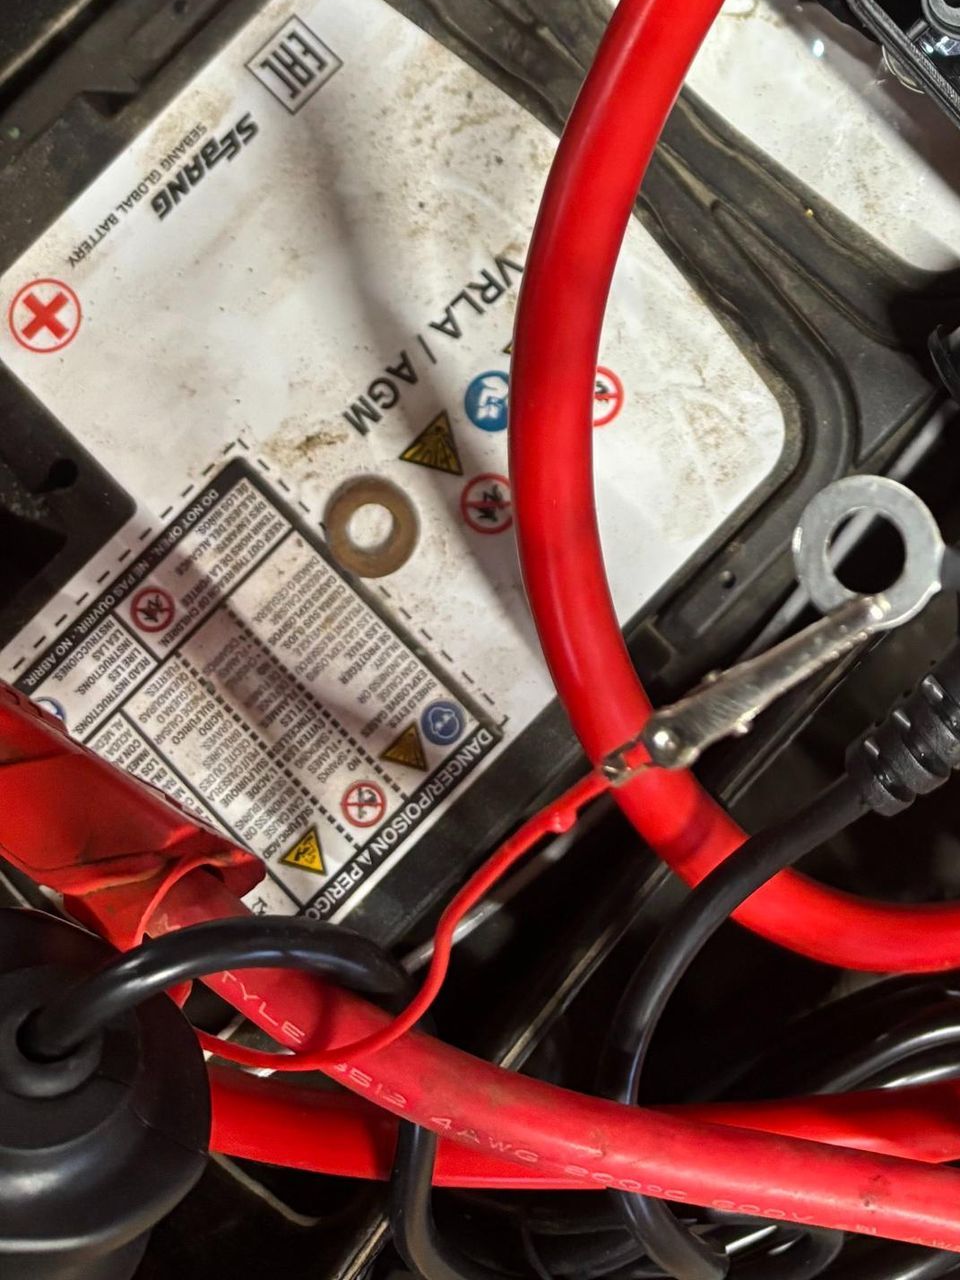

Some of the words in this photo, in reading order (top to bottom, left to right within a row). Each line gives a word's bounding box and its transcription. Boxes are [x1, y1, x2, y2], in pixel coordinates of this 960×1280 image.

[157, 121, 207, 171] SEBANG
[148, 111, 261, 221] SEBANG
[114, 167, 163, 217] GLOBAL
[64, 212, 119, 268] BATTERY
[428, 257, 524, 337] VRLA
[341, 348, 418, 437] AGM
[200, 488, 220, 509] DO
[218, 492, 239, 513] LOS
[247, 499, 268, 521] DES
[178, 503, 205, 530] NOT
[229, 531, 255, 557] HORS
[261, 518, 286, 544] KEEP
[218, 552, 234, 569] DE
[246, 538, 266, 559] OUT
[208, 563, 223, 579] LA
[111, 572, 136, 597] PAS
[205, 569, 236, 600] REACH
[72, 592, 116, 636] OUVRIR.
[195, 594, 210, 611] OF
[301, 608, 322, 629] SUS
[363, 620, 383, 641] LES
[52, 635, 73, 657] NO
[104, 627, 124, 648] LEA
[50, 618, 115, 684] INSTRUCCIONES.
[90, 642, 110, 662] LAS
[120, 646, 142, 669] LIRE
[73, 636, 133, 697] INSTRUCTIONS.
[106, 663, 125, 683] LES
[126, 655, 151, 681] READ
[399, 658, 419, 679] CAN
[136, 670, 190, 724] QUEMADURAS
[376, 673, 404, 703] CAUSE
[384, 668, 428, 713] EXPLOSIVE
[70, 676, 131, 737] INSTRUCTIONS.
[278, 707, 298, 728] LES
[293, 697, 308, 713] ET
[151, 712, 185, 746] CAUSAR
[359, 708, 389, 738] GASES
[306, 740, 339, 775] FLAMES
[315, 750, 348, 784] SPARKS
[197, 772, 217, 793] DES
[218, 756, 270, 809] SULFURIQUE
[244, 766, 278, 800] L'ACIDE
[367, 726, 496, 857] DANGER/POISON
[252, 785, 296, 830] BLINDNESS
[285, 794, 306, 815] CAN
[241, 824, 257, 841] OR
[262, 810, 290, 839] CAUSE
[260, 837, 281, 860] ACID
[220, 969, 305, 1045] TYLE
